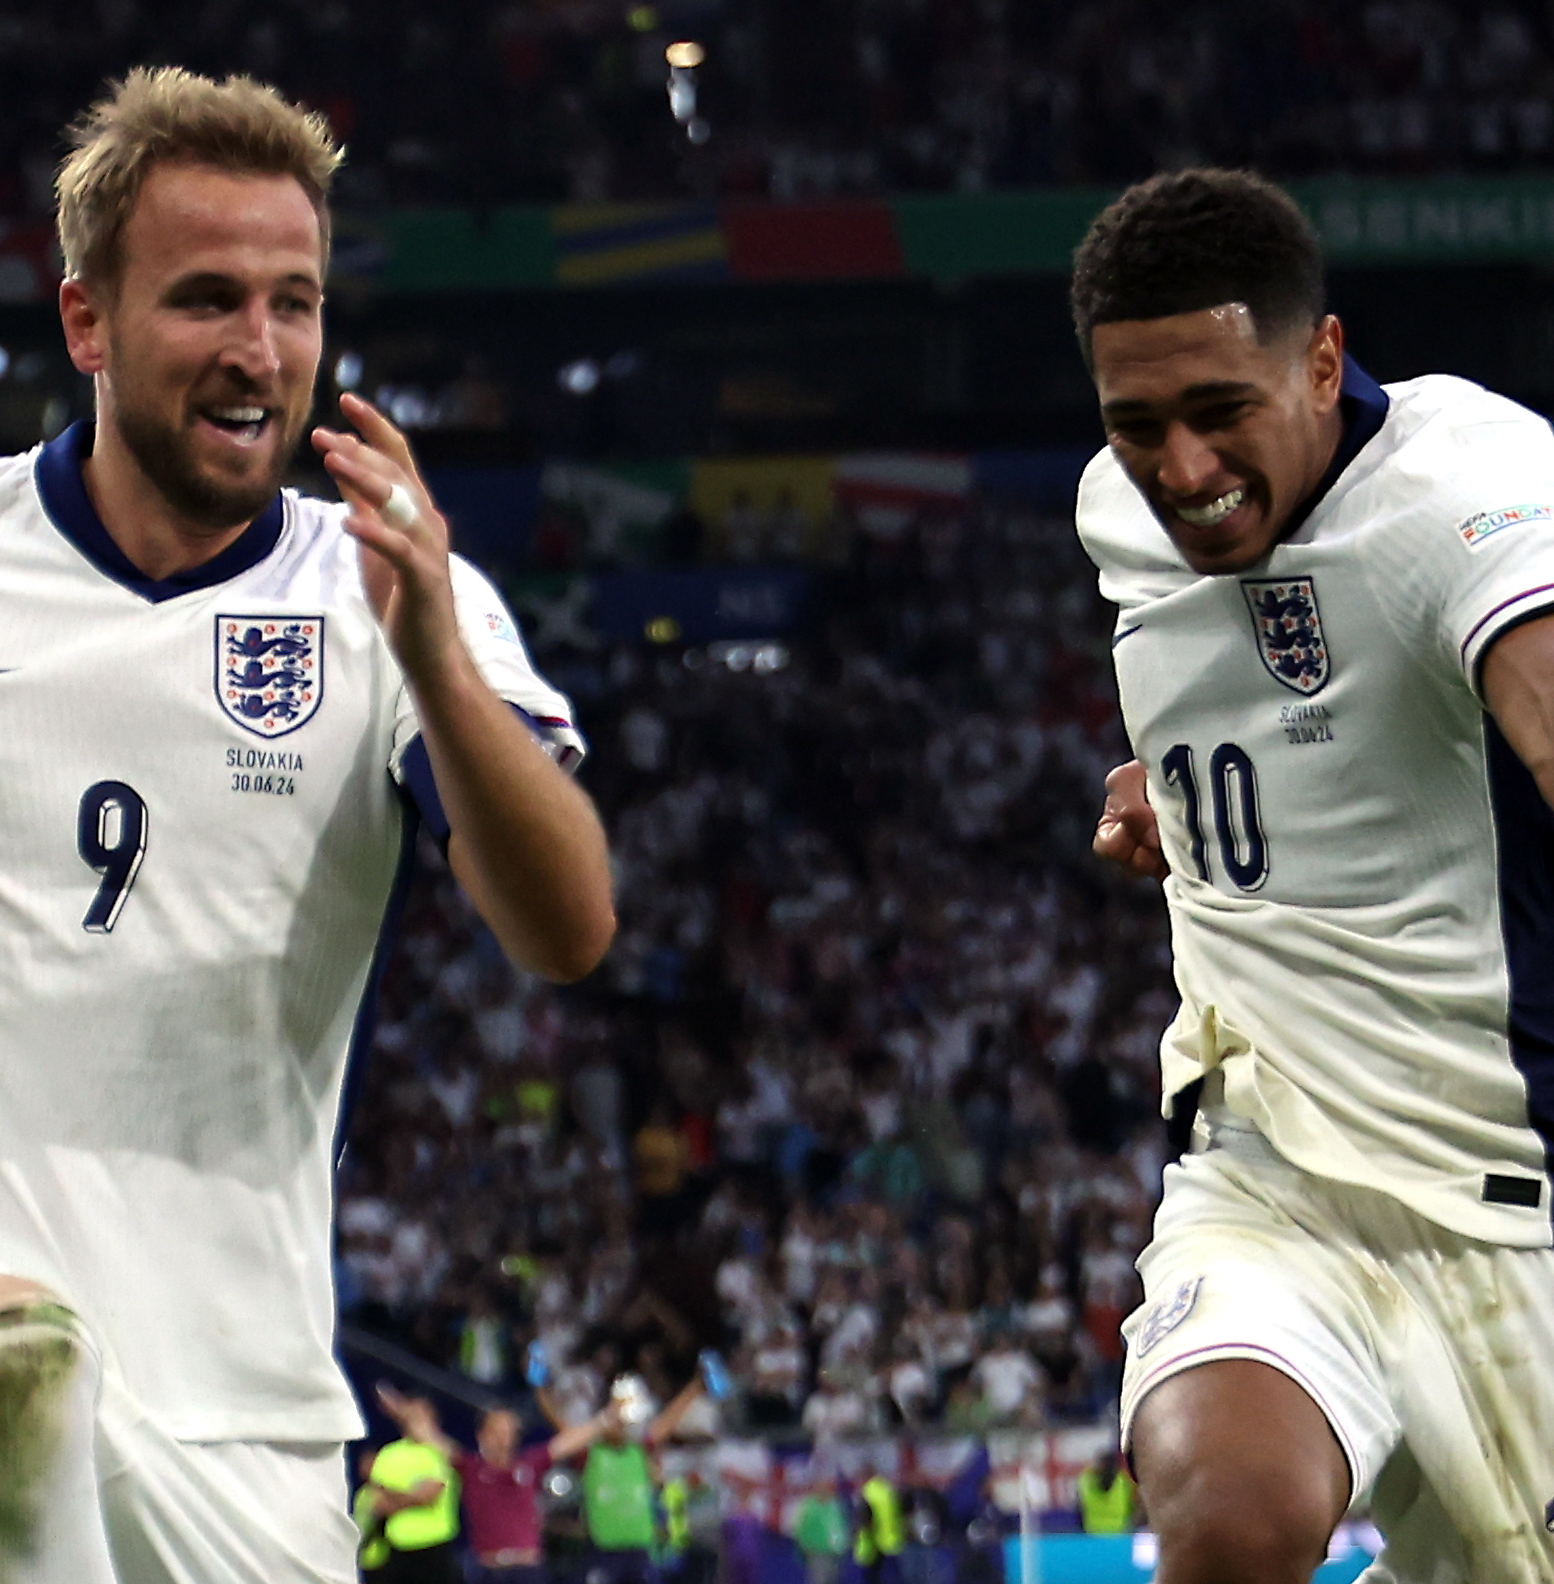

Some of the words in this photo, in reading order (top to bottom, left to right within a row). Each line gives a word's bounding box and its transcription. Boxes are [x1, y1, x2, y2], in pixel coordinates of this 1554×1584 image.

[226, 748, 303, 771] SLOVAKIA
[231, 774, 294, 795] 30.06.24
[76, 780, 149, 935] 9
[1158, 741, 1269, 892] 10
